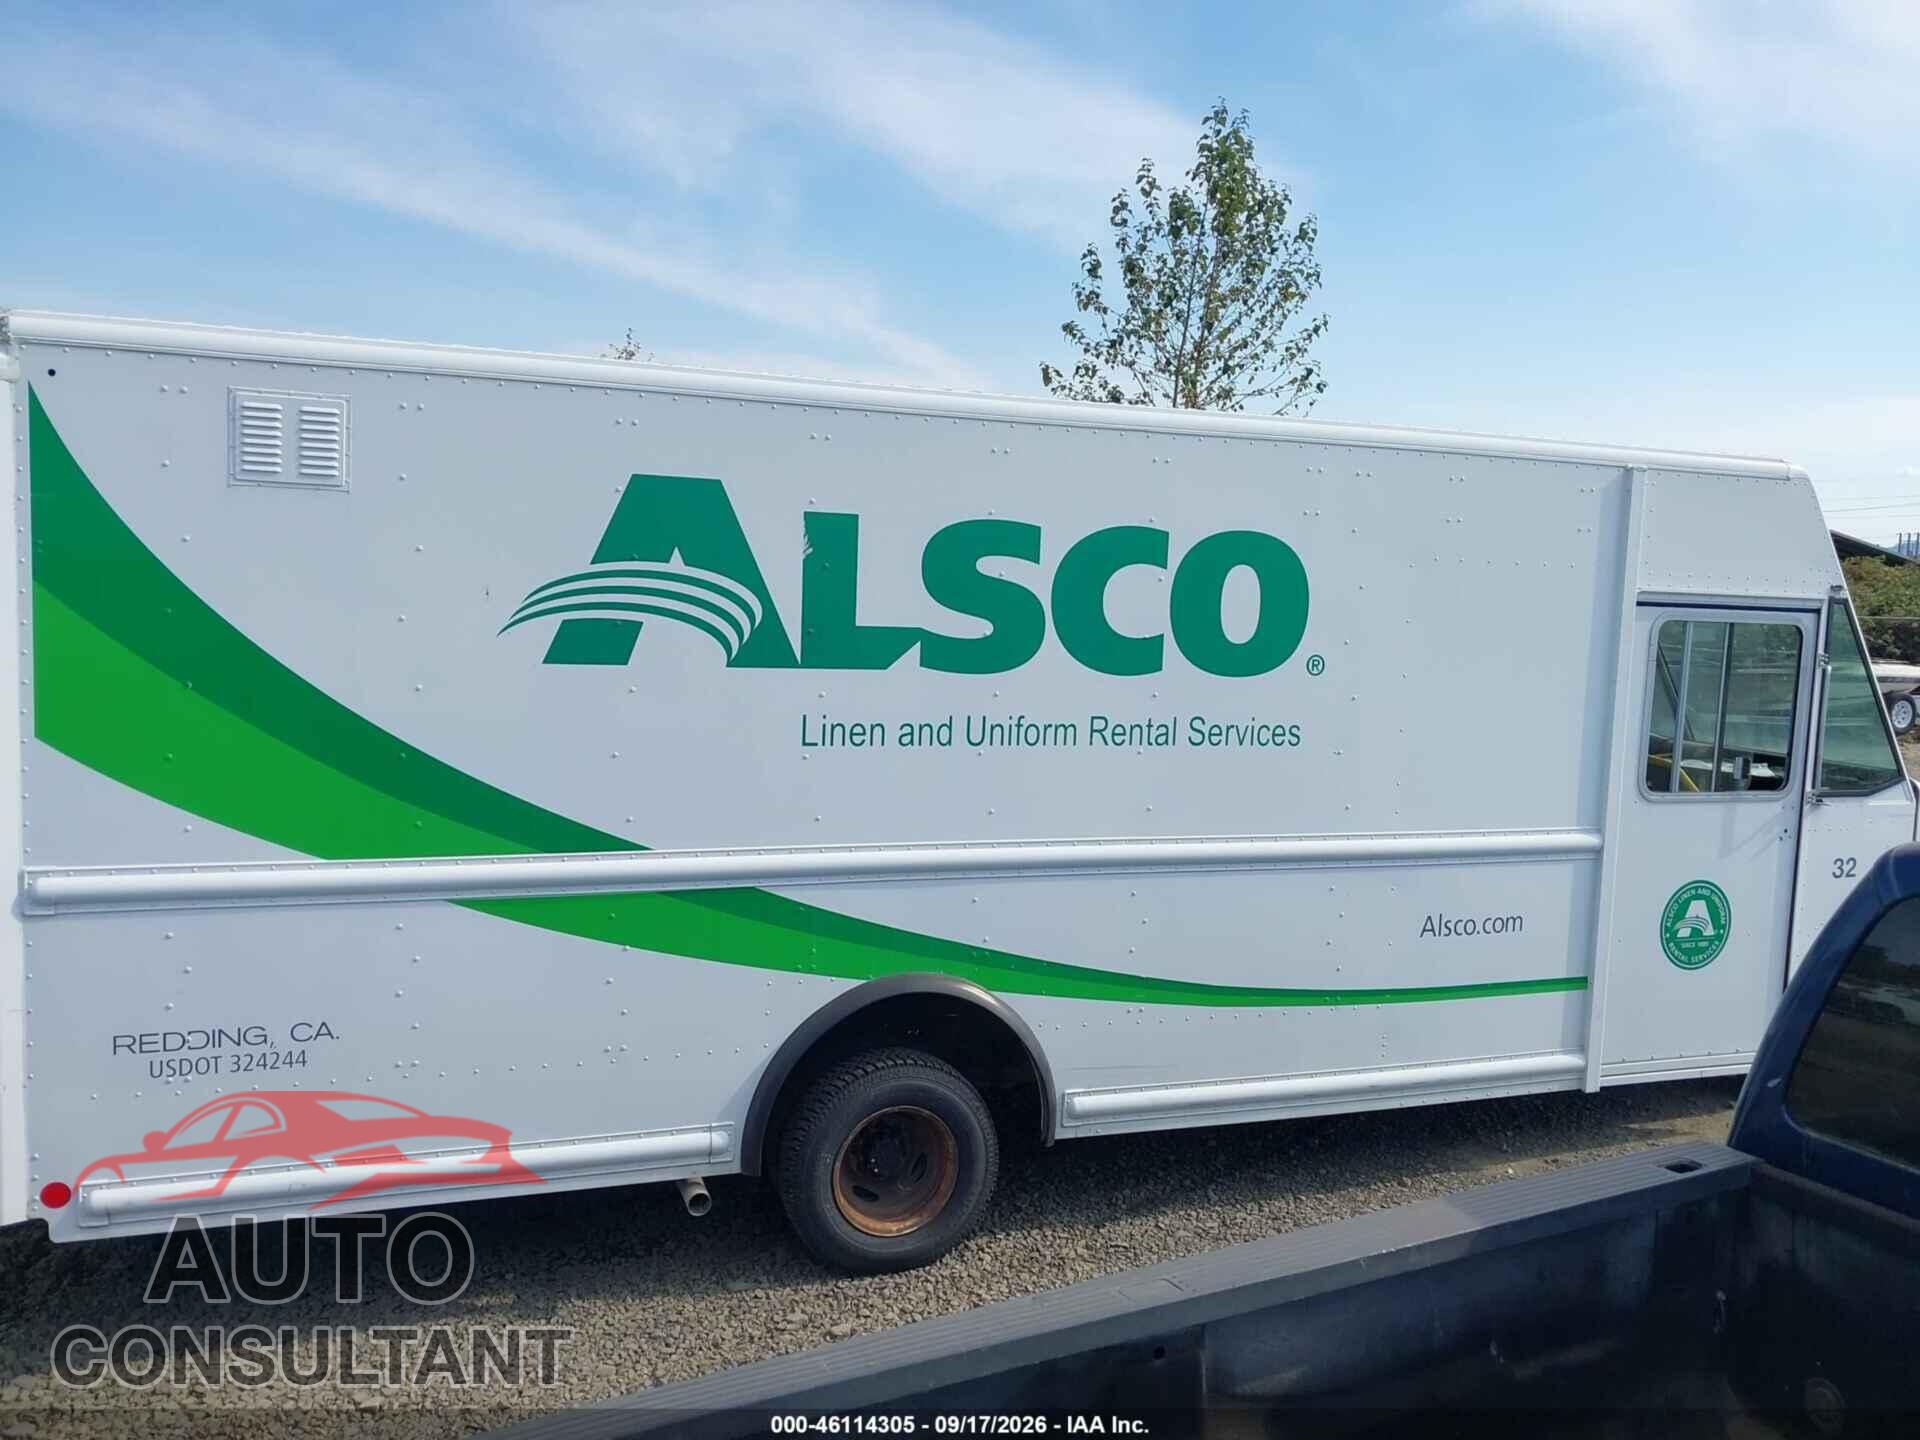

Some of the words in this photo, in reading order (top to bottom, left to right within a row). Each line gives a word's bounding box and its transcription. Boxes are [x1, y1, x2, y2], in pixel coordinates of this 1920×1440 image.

[497, 473, 1310, 678] ALSCO
[801, 714, 886, 747] Linen
[898, 715, 953, 747] and
[966, 715, 1077, 747] Uniform
[1089, 715, 1177, 747] Rental
[1188, 715, 1301, 747] Services
[1832, 857, 1857, 879] 32
[1697, 887, 1711, 896] AND
[1419, 913, 1524, 938] Alsco.com
[113, 1026, 276, 1055] REDDING,
[290, 1022, 340, 1042] CA.
[149, 1056, 223, 1079] USDOT
[230, 1050, 308, 1073] 324244
